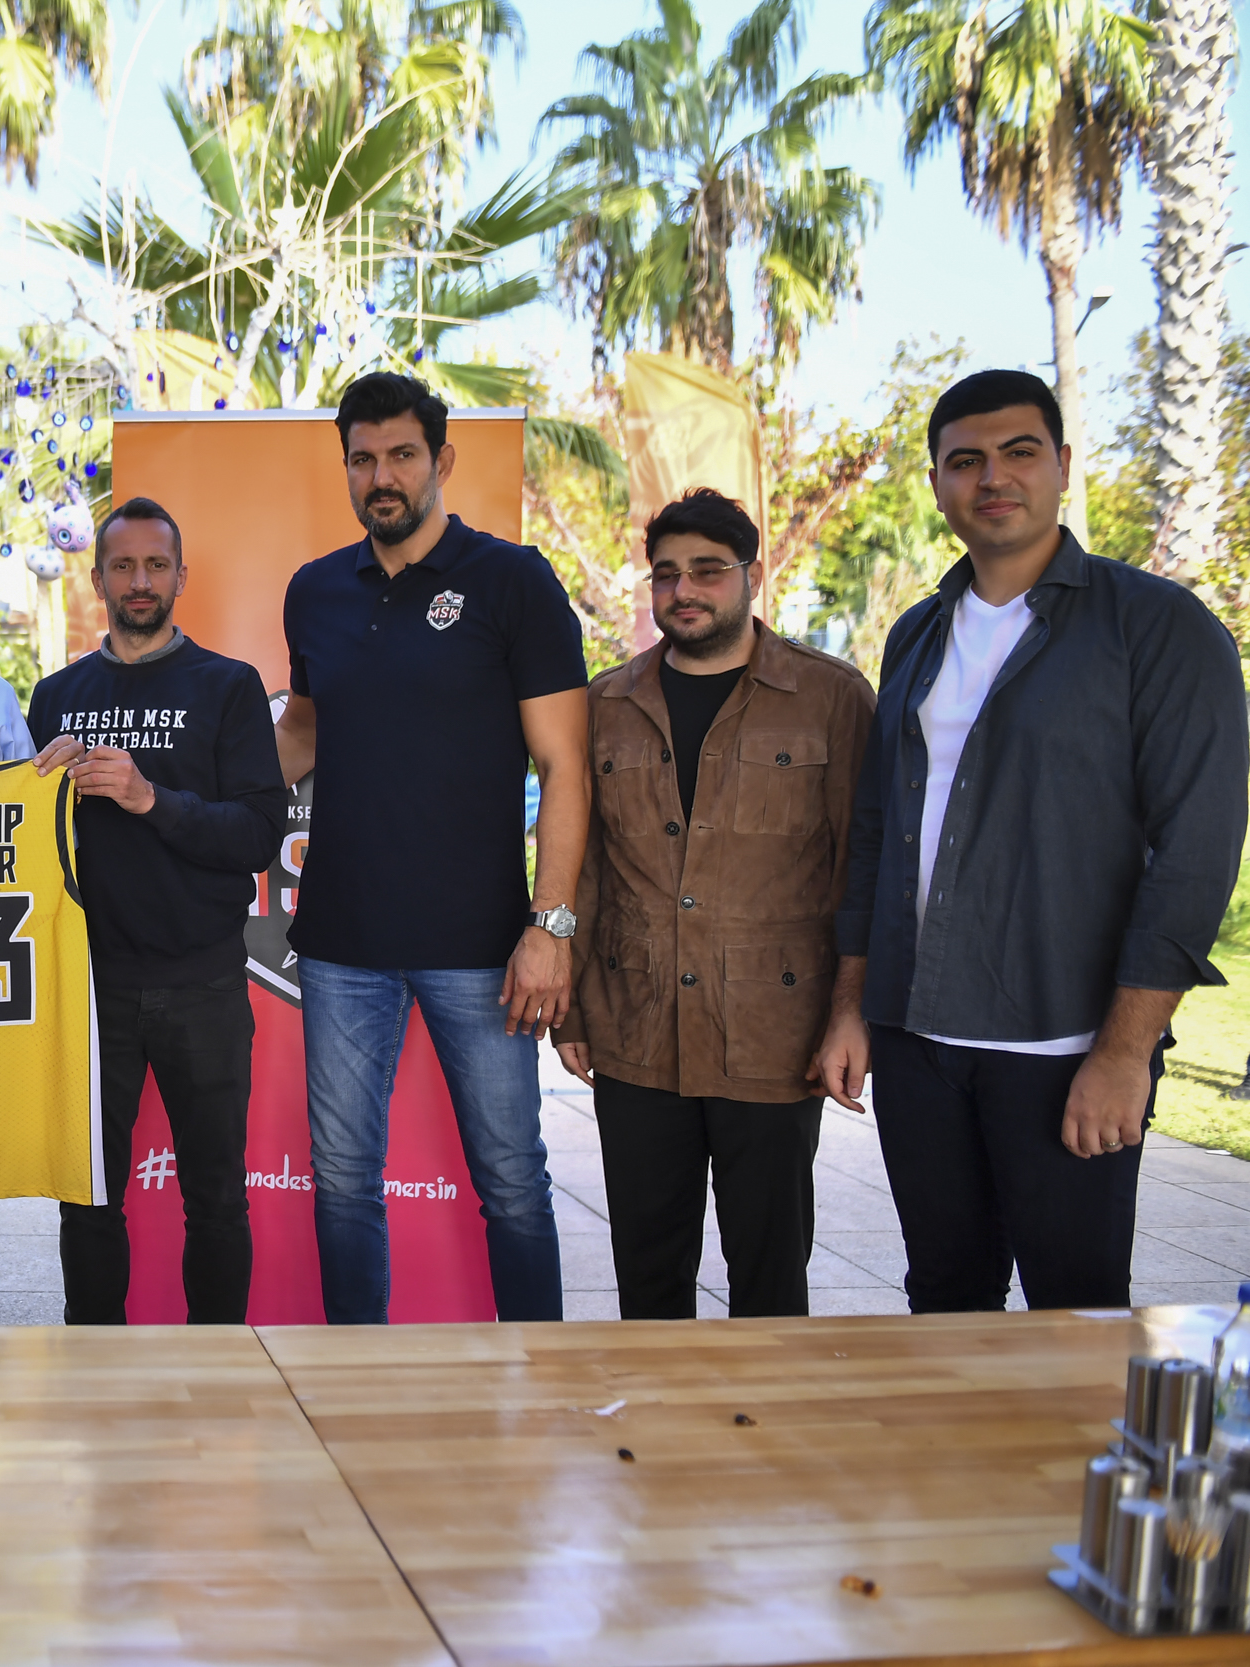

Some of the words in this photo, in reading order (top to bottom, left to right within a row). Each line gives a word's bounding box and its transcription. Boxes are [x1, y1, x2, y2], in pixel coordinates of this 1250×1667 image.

[429, 606, 460, 620] MSK
[59, 706, 135, 732] MERSİN
[142, 709, 187, 729] MSK
[69, 731, 174, 750] ASKETBALL
